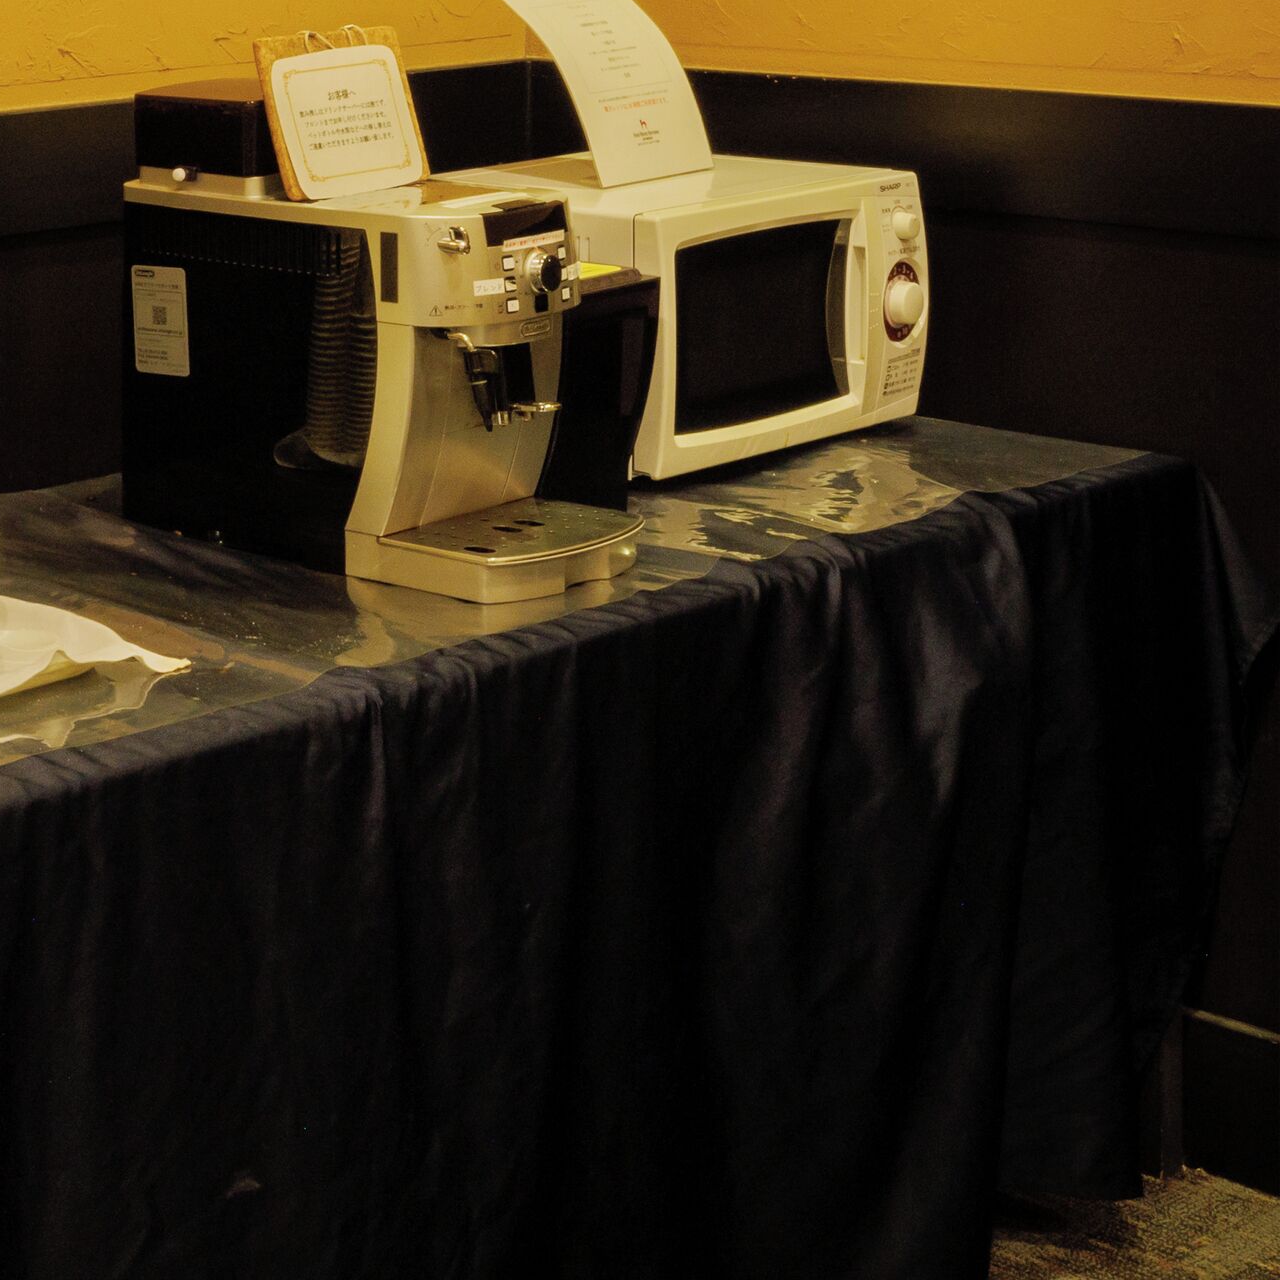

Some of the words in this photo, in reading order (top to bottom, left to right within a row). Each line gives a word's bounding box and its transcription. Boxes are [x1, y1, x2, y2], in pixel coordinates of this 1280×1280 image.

[328, 89, 356, 100] お客様へ
[880, 182, 901, 193] SHARP
